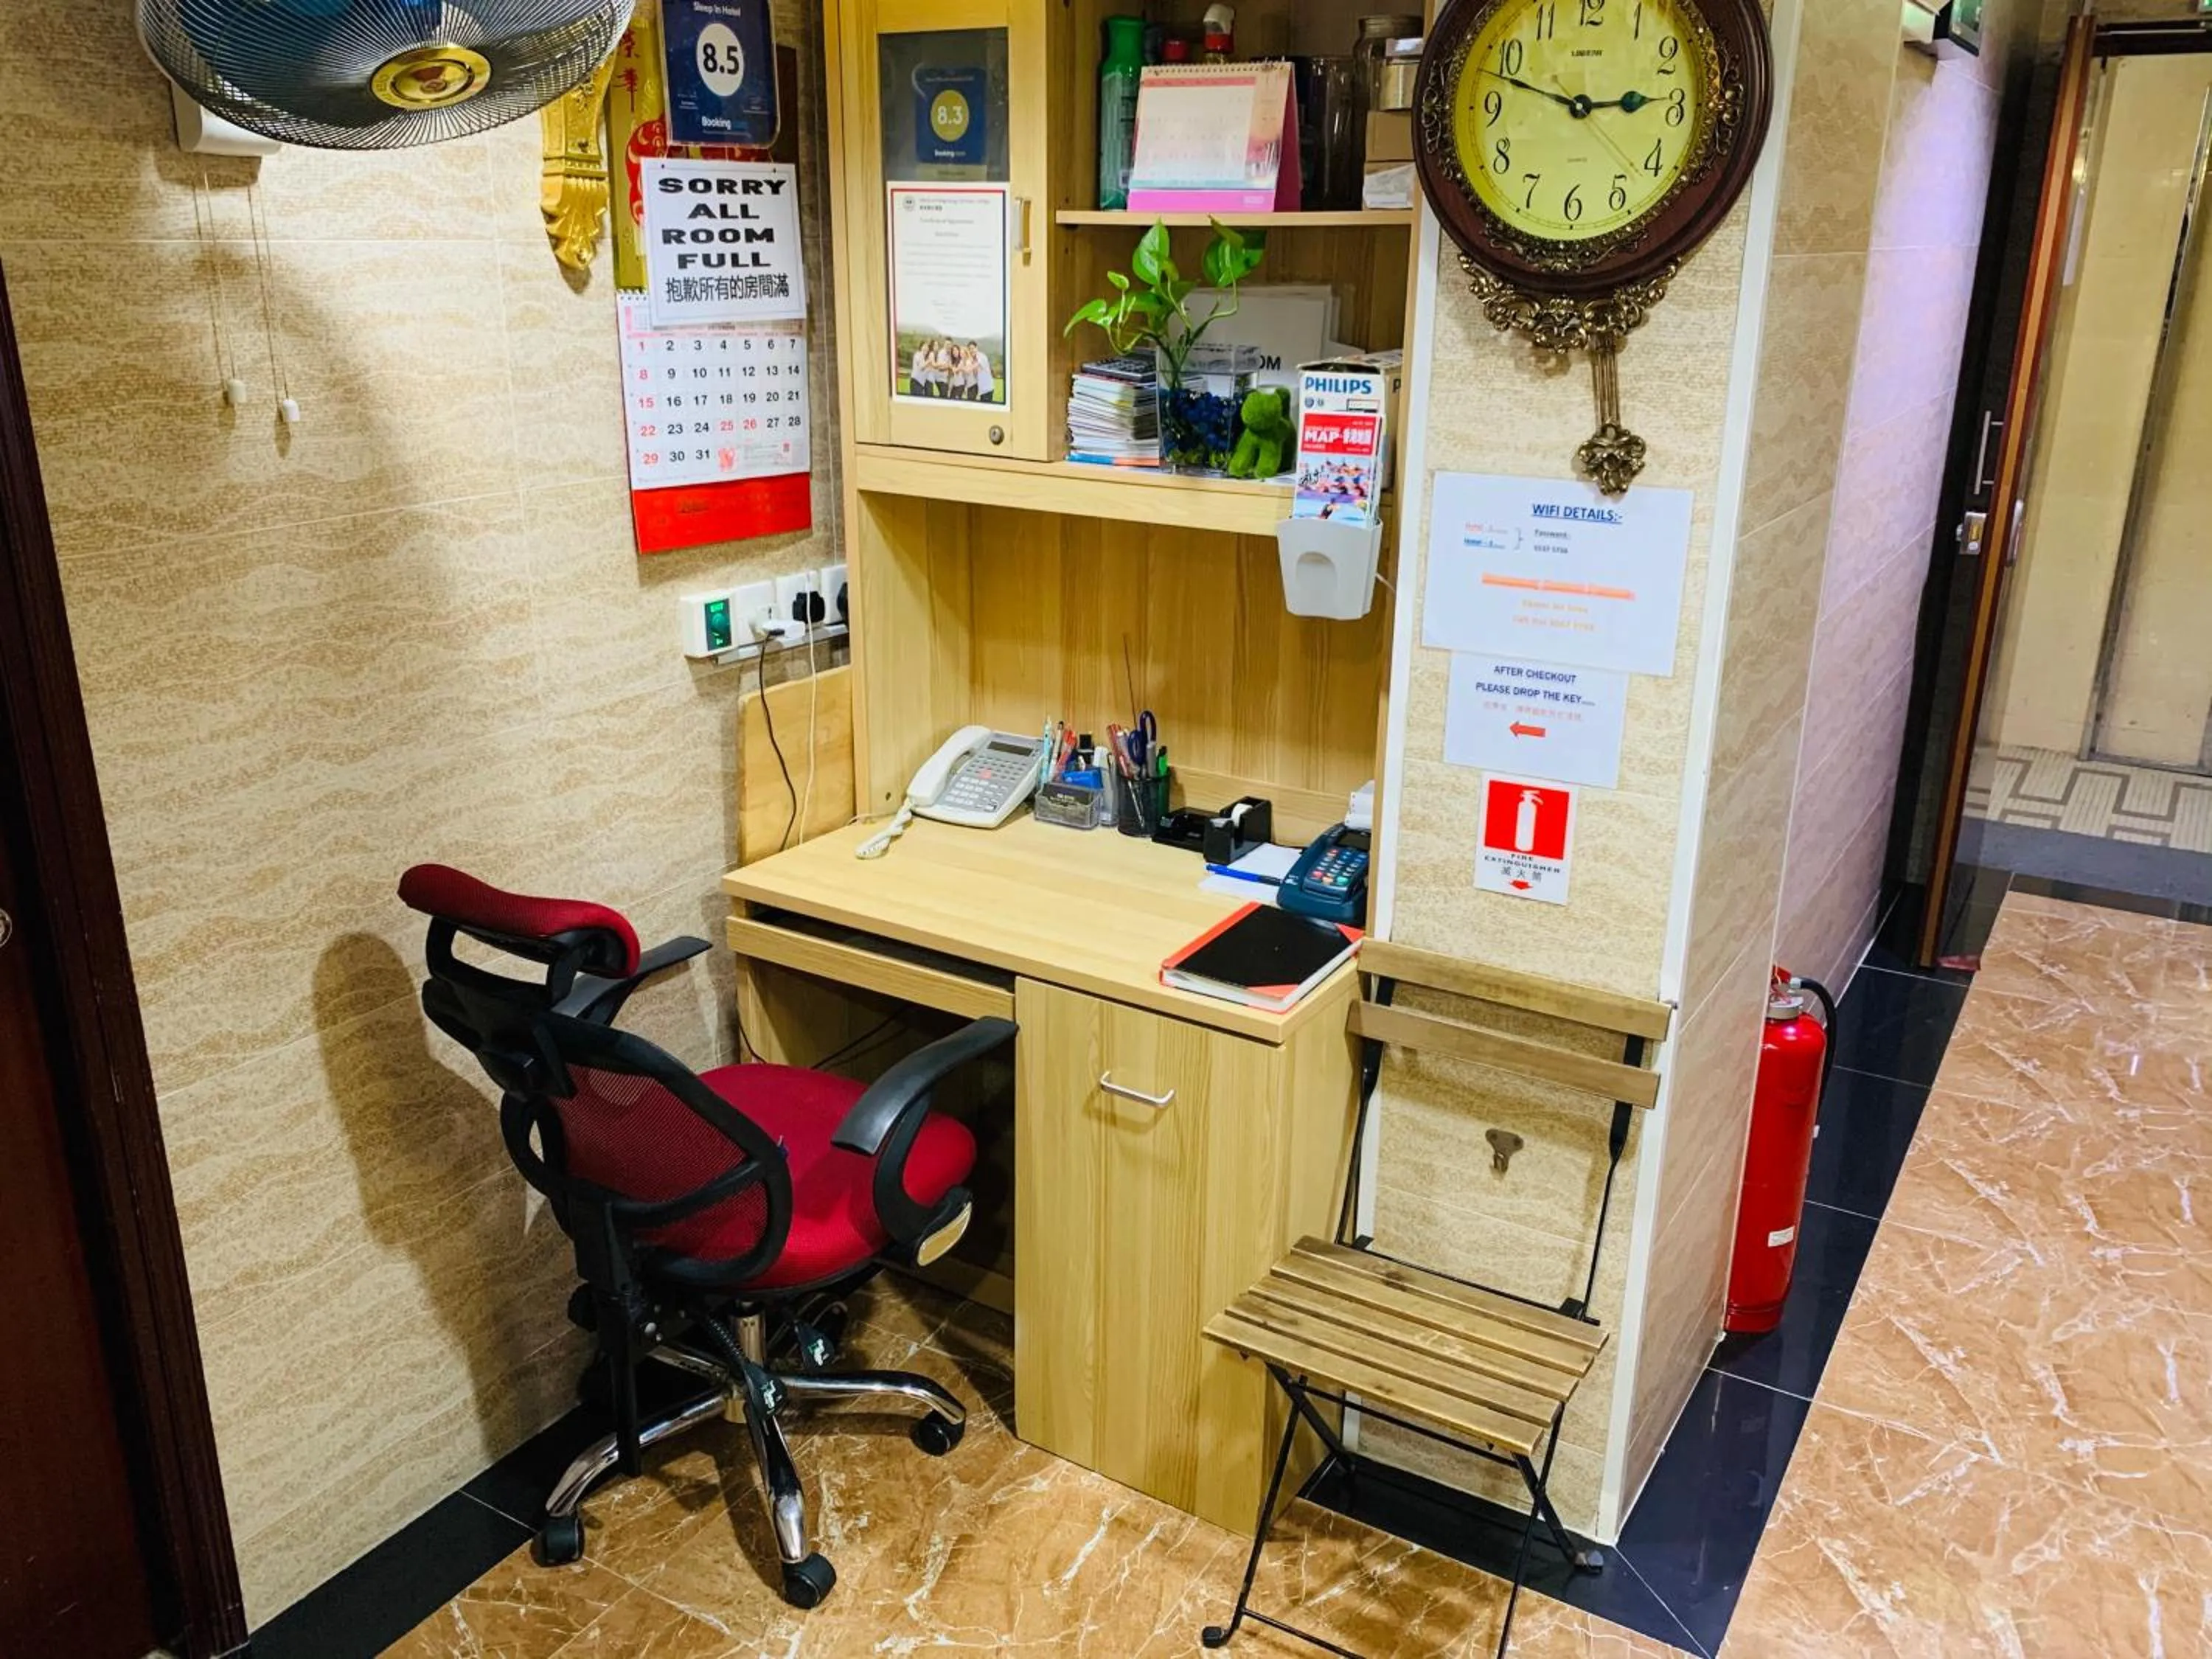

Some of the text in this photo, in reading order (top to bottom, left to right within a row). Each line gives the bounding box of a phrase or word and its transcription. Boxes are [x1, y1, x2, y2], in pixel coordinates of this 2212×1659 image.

[723, 5, 741, 17] Hotel
[1580, 0, 1604, 26] 12
[1536, 4, 1555, 41] 11
[1634, 1, 1642, 41] 1
[703, 43, 740, 74] 8.5
[1499, 38, 1523, 77] 10
[1657, 35, 1678, 74] 2
[937, 106, 963, 125] 8.3
[1484, 91, 1502, 128] 9
[1666, 88, 1686, 127] 3
[1493, 137, 1510, 175] 8
[1644, 138, 1663, 177] 4
[658, 178, 787, 195] SORRY
[1523, 173, 1540, 209] 7
[1609, 175, 1627, 211] 5
[687, 204, 760, 220] ALL
[1564, 184, 1583, 221] 6
[662, 228, 775, 245] ROOM
[678, 252, 772, 270] FULL
[666, 273, 790, 304] 抱歉所有的房間滿
[639, 338, 796, 351] 1 2 3 4 5 6 7
[639, 365, 800, 380] 8 9 10 11 12 13 14
[1304, 377, 1372, 394] PHILIPS
[639, 391, 800, 408] 15 16 17 18 19 20 21
[640, 417, 801, 437] 22 23 24 25 26 27 28
[1304, 429, 1340, 443] MAP
[642, 449, 710, 465] 29 30 31
[1532, 504, 1560, 517] WIFI
[1494, 666, 1576, 684] AFTER CHECKOUT
[1475, 682, 1511, 695] PLEASE
[1513, 686, 1540, 697] DROP
[1543, 690, 1559, 701] THE
[1484, 855, 1560, 873] EXTINGUISHER
[1511, 853, 1534, 861] FIRE
